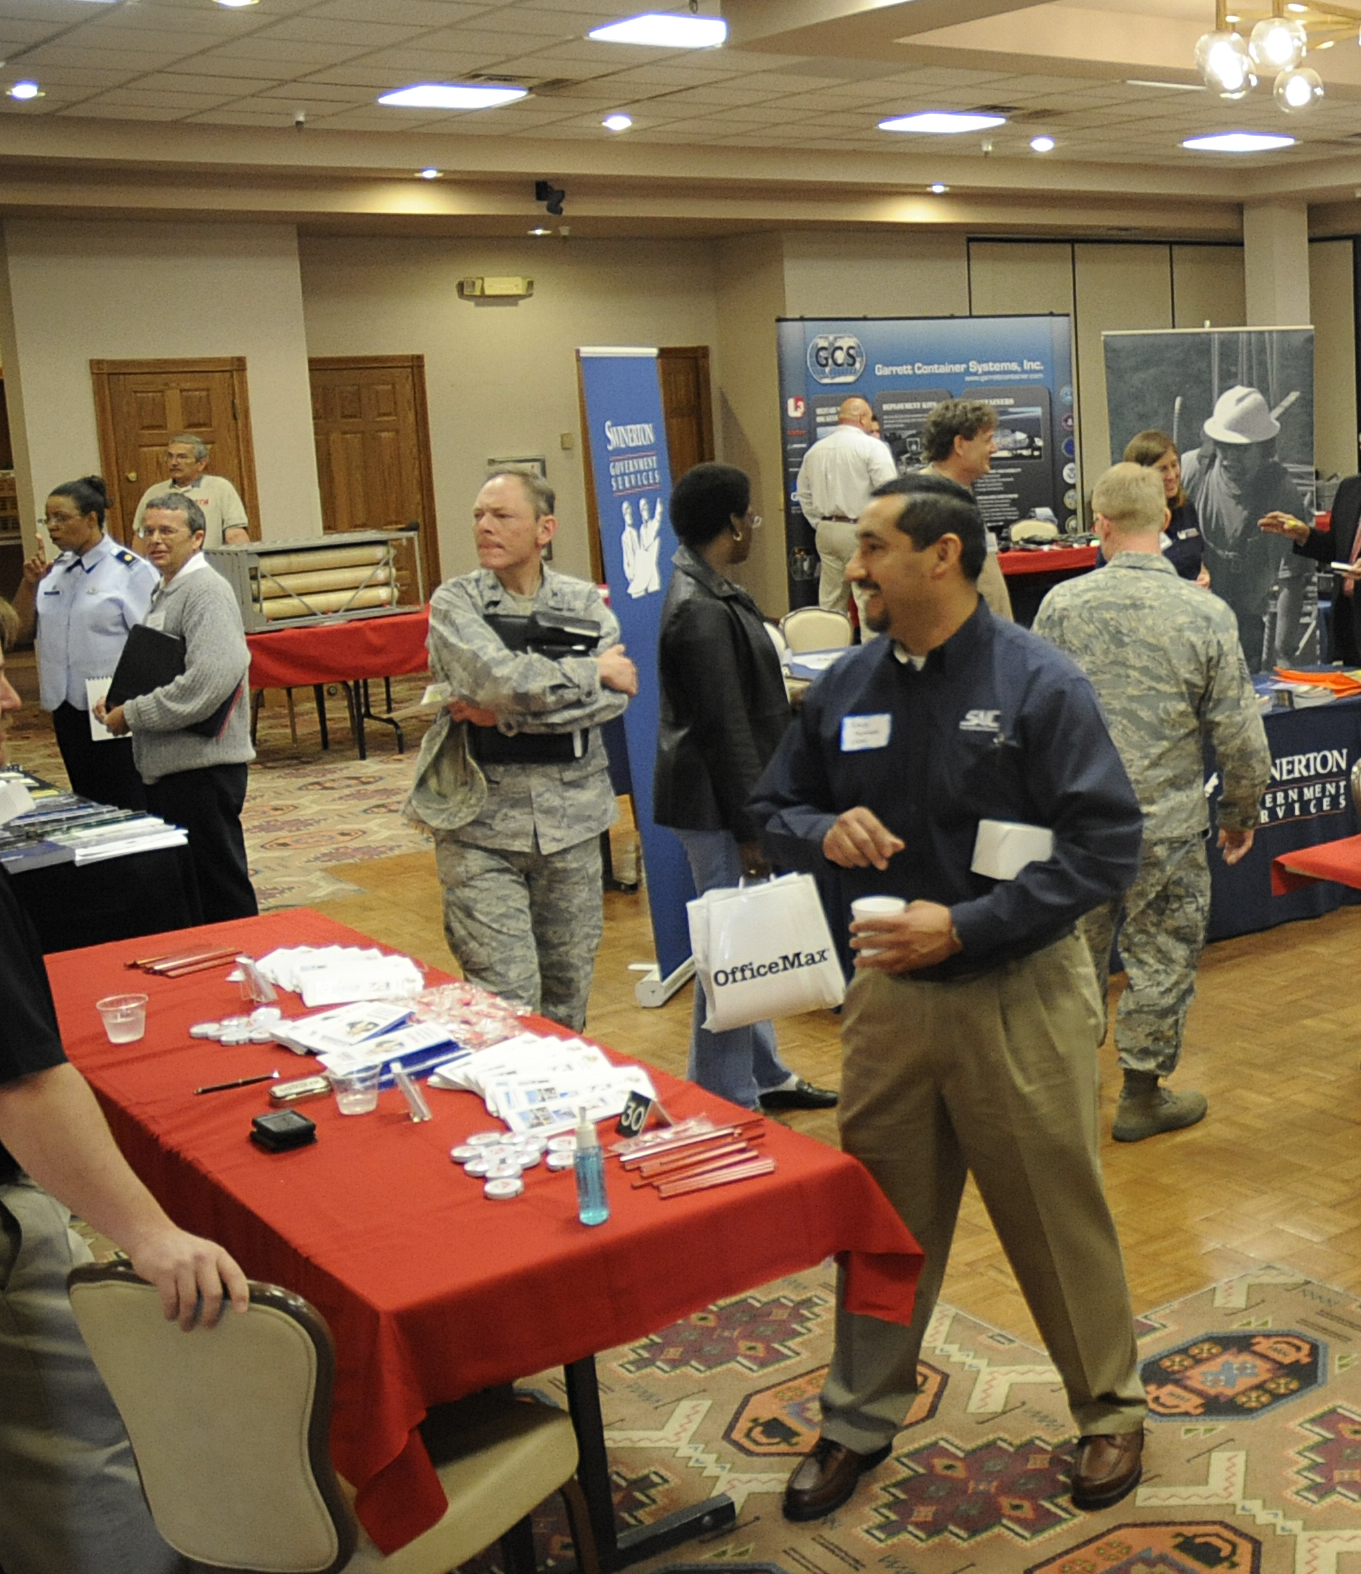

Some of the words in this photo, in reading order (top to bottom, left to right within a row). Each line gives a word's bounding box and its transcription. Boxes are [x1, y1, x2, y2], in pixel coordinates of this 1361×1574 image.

[815, 346, 857, 368] GCS
[875, 363, 913, 376] Garrett
[914, 361, 966, 375] Container
[968, 359, 1021, 374] Systems,
[1023, 358, 1044, 371] Inc.
[604, 420, 655, 451] SWINERTON
[609, 456, 657, 476] GOVERNMENT
[611, 470, 660, 491] SERVICES
[1267, 748, 1348, 783] NERTON
[713, 949, 829, 987] OfficeMax
[621, 1101, 646, 1131] 30
